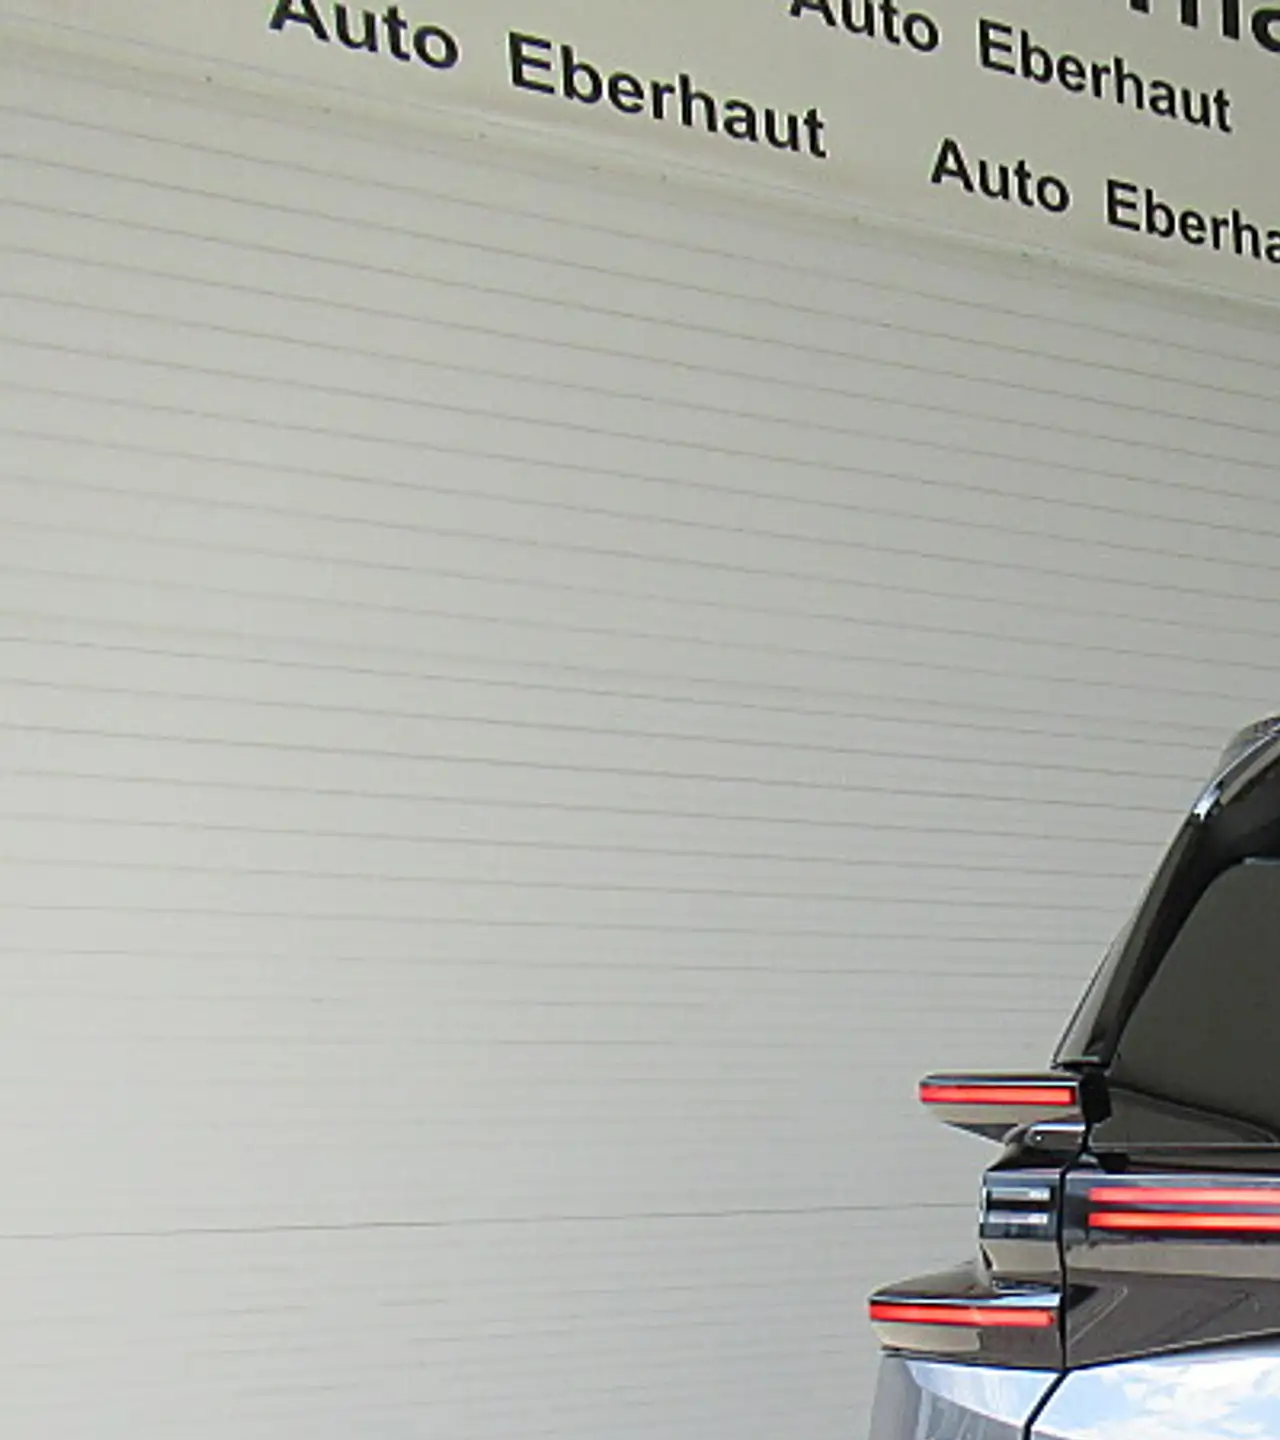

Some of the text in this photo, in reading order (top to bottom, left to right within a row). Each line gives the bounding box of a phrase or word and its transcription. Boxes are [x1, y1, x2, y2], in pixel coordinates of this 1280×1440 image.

[270, 0, 828, 159] Auto Eberhaut
[979, 18, 1233, 133] Eberhaut
[930, 138, 1070, 213] Auto
